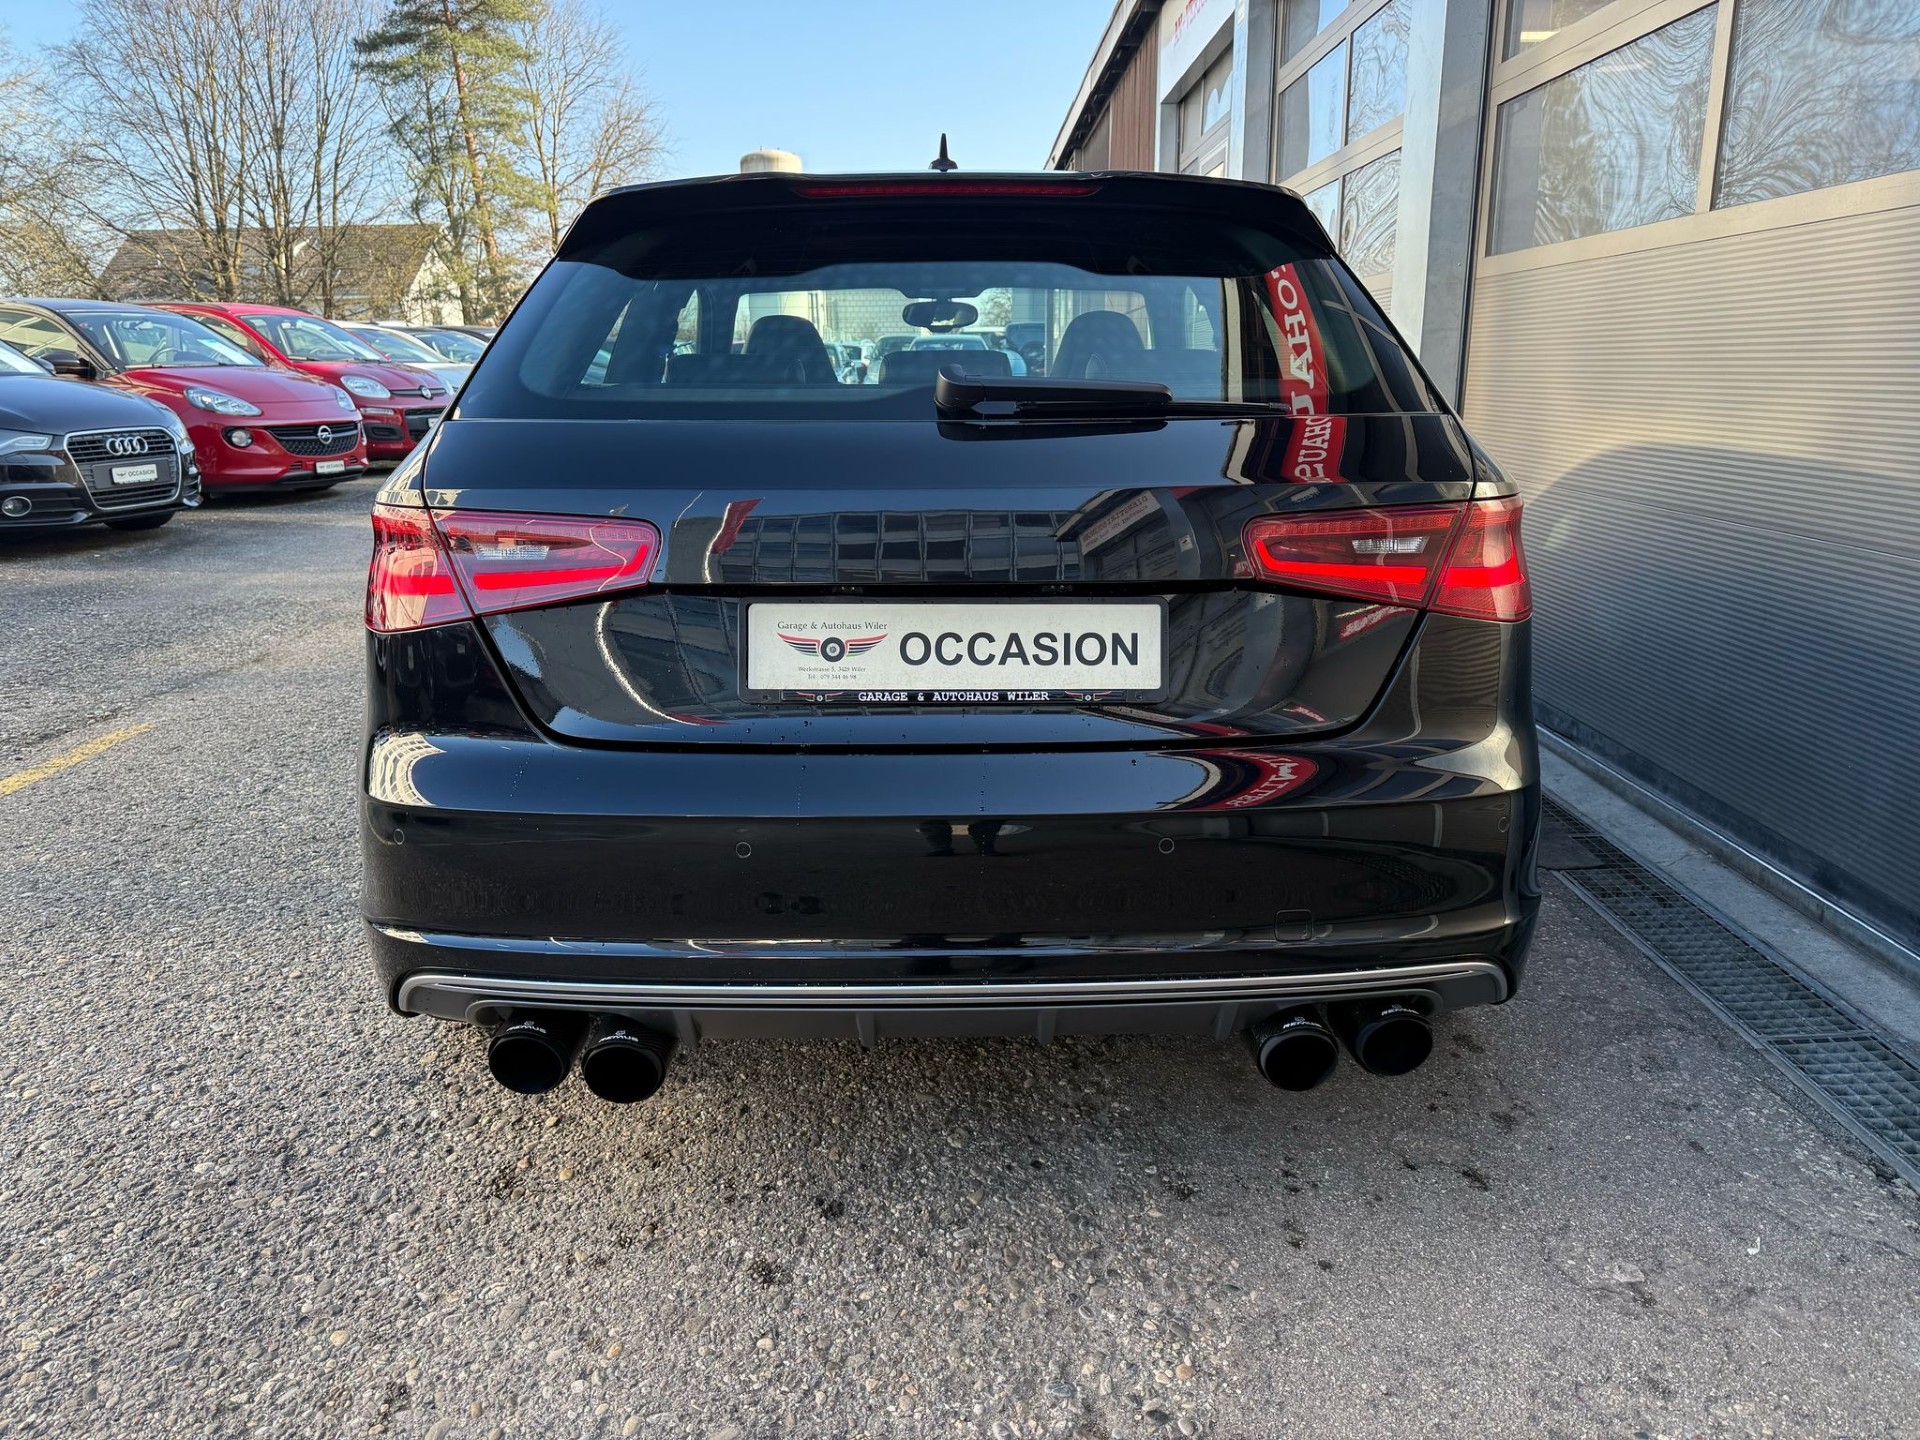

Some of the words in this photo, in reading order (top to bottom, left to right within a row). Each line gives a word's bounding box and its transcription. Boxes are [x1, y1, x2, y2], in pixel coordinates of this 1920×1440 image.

[128, 469, 155, 477] OCCASION
[777, 621, 807, 632] Garage
[811, 622, 817, 630] &
[821, 622, 861, 630] Autohaus
[864, 622, 887, 630] Wiler
[900, 631, 1138, 666] OCCASION
[858, 691, 907, 702] GARAGE
[918, 691, 925, 702] &
[933, 691, 999, 702] AUTOHAUS
[1007, 691, 1050, 702] WILER
